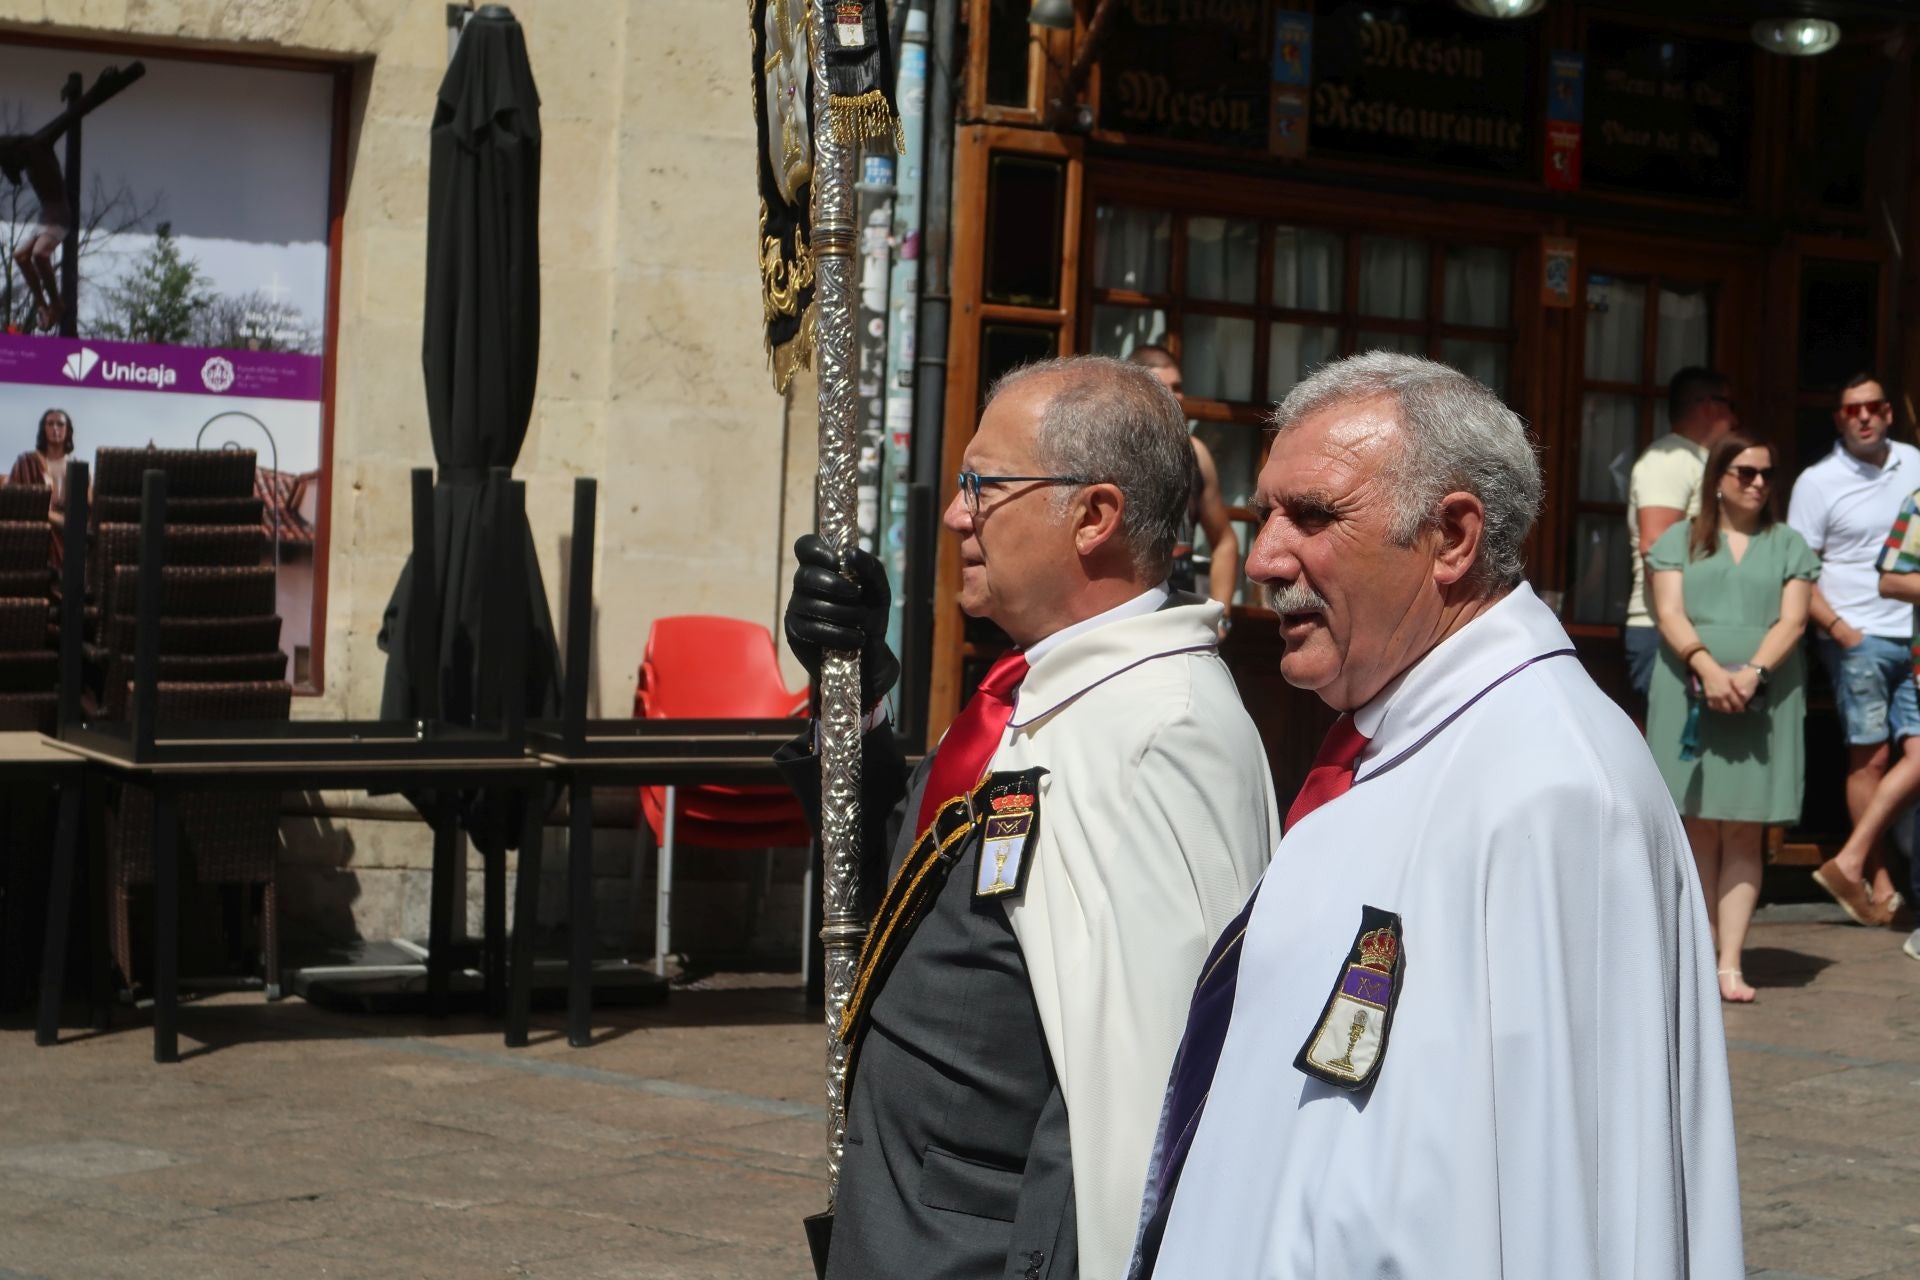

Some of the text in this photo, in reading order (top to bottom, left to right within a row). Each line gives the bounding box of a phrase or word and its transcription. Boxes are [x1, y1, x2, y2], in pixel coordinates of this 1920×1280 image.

[1118, 69, 1250, 131] Mesón
[1314, 82, 1522, 150] Restaurante
[102, 360, 177, 389] Unicaja
